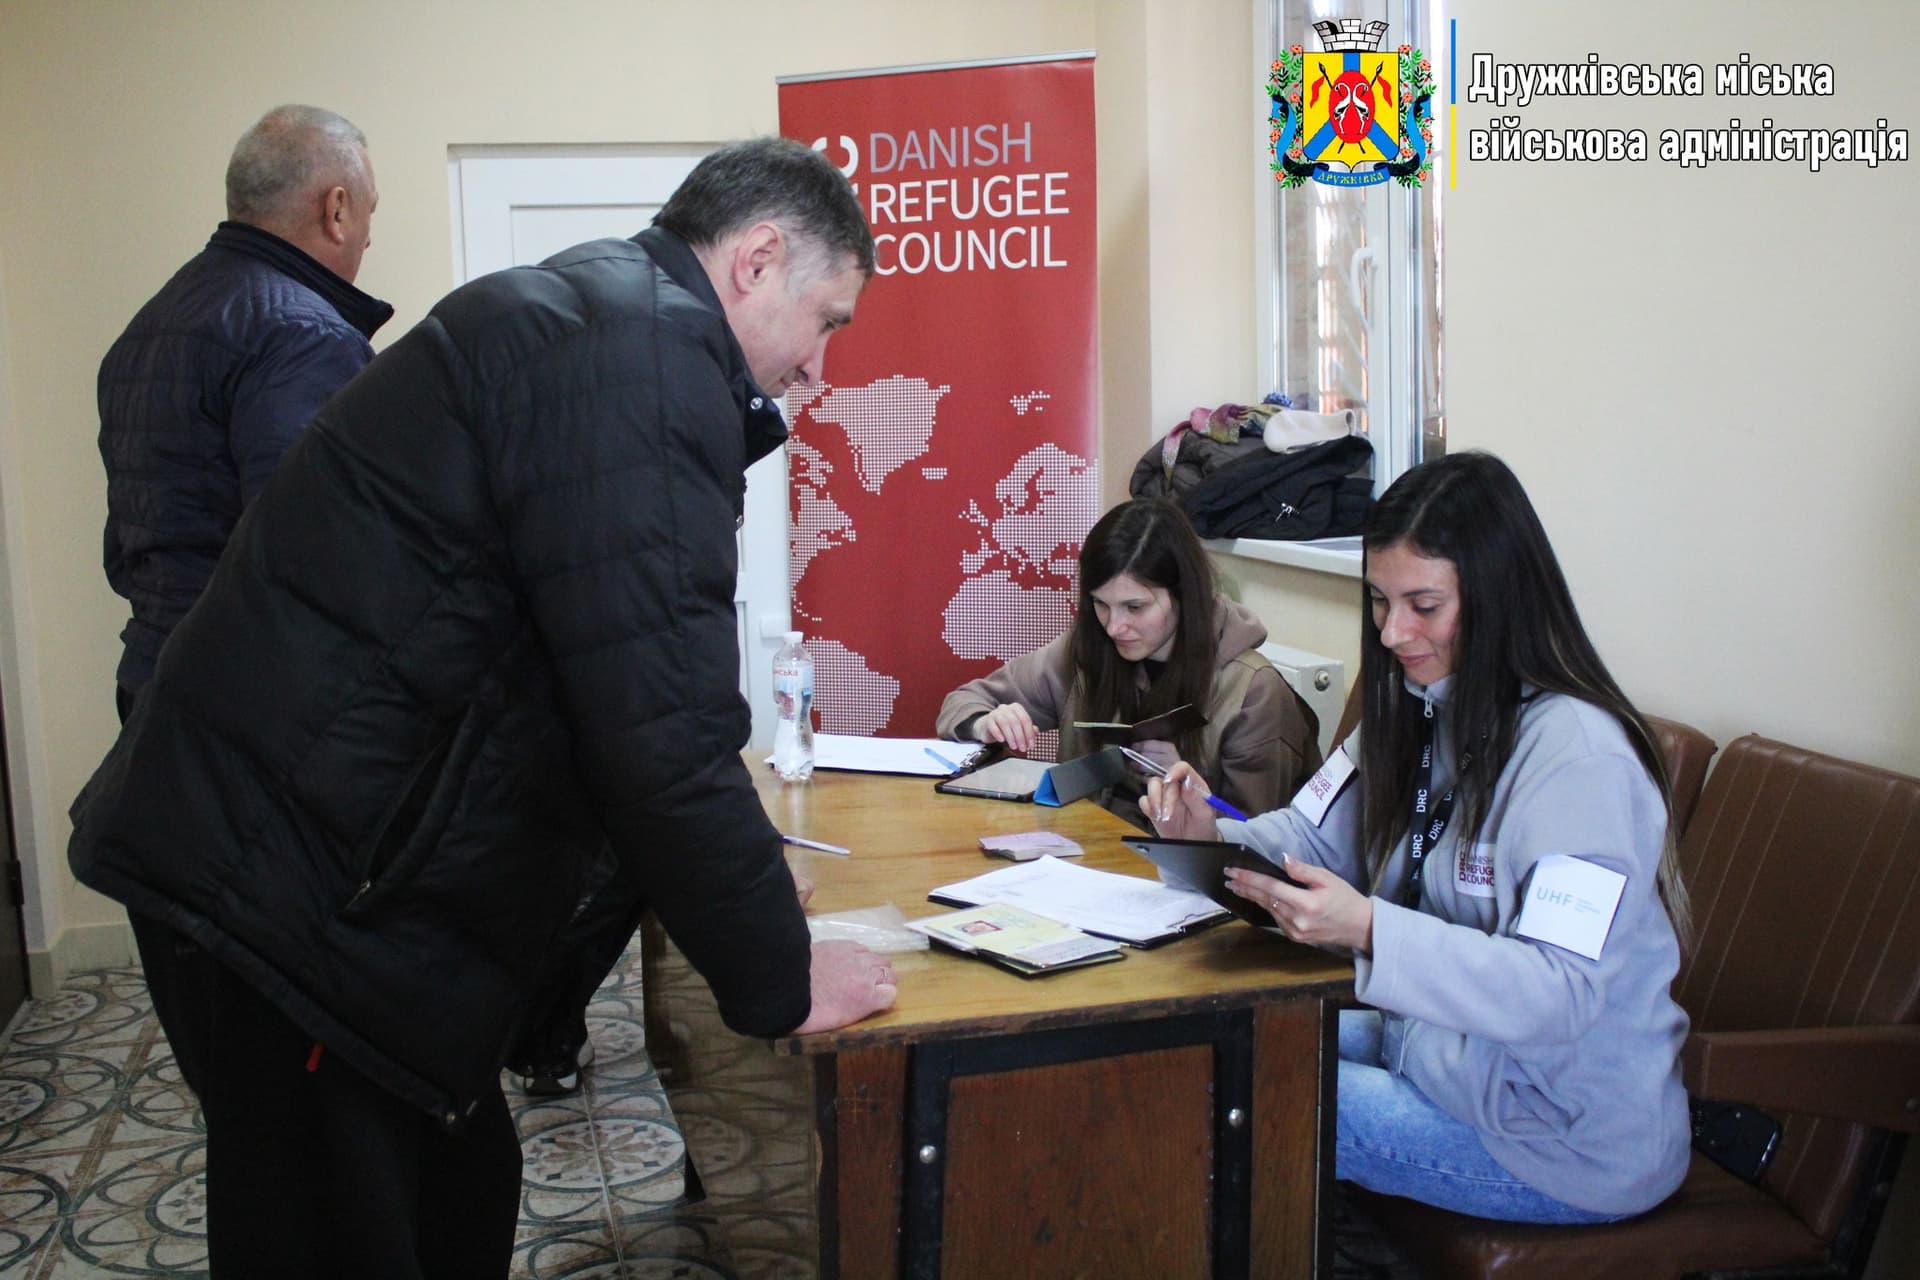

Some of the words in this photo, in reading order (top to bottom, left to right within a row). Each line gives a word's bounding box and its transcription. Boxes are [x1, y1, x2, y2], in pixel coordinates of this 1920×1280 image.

[869, 121, 1032, 174] DANISH
[870, 172, 1070, 225] REFUGEE
[873, 225, 1068, 276] COUNCIL
[1421, 744, 1432, 768] DRC
[1416, 788, 1428, 812] DRC
[1428, 819, 1444, 841] DRC
[1412, 834, 1424, 858] DRC
[1536, 886, 1574, 907] UHF
